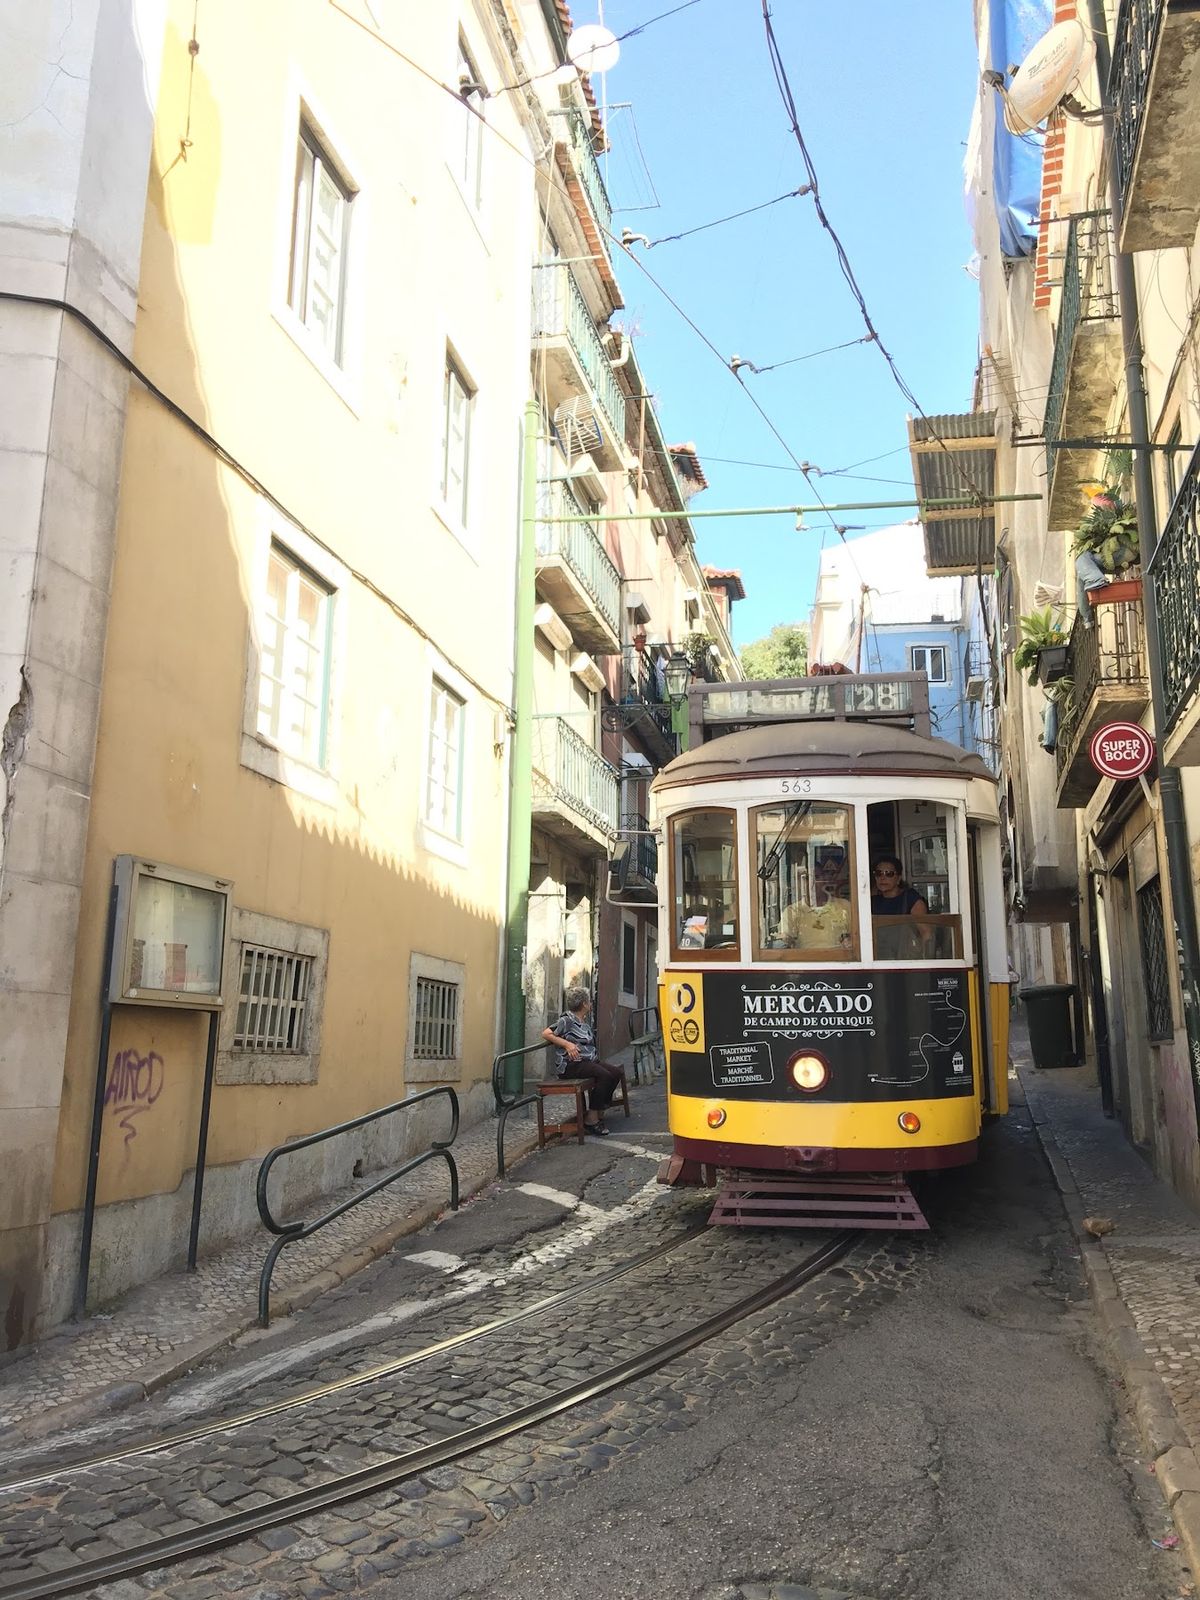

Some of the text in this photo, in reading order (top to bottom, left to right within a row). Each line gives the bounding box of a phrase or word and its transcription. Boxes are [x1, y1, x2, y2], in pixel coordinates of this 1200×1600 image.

[856, 683, 897, 711] 28
[1102, 739, 1140, 751] SUPER
[1105, 750, 1140, 761] BOCK
[781, 779, 812, 793] 563
[743, 994, 872, 1013] MERCADO
[744, 1016, 873, 1027] DE CAMPO DE OURIQUE
[719, 1046, 758, 1055] TRADITIONAL
[726, 1055, 752, 1063] MARKET
[720, 1074, 764, 1083] TRADITIONNEL
